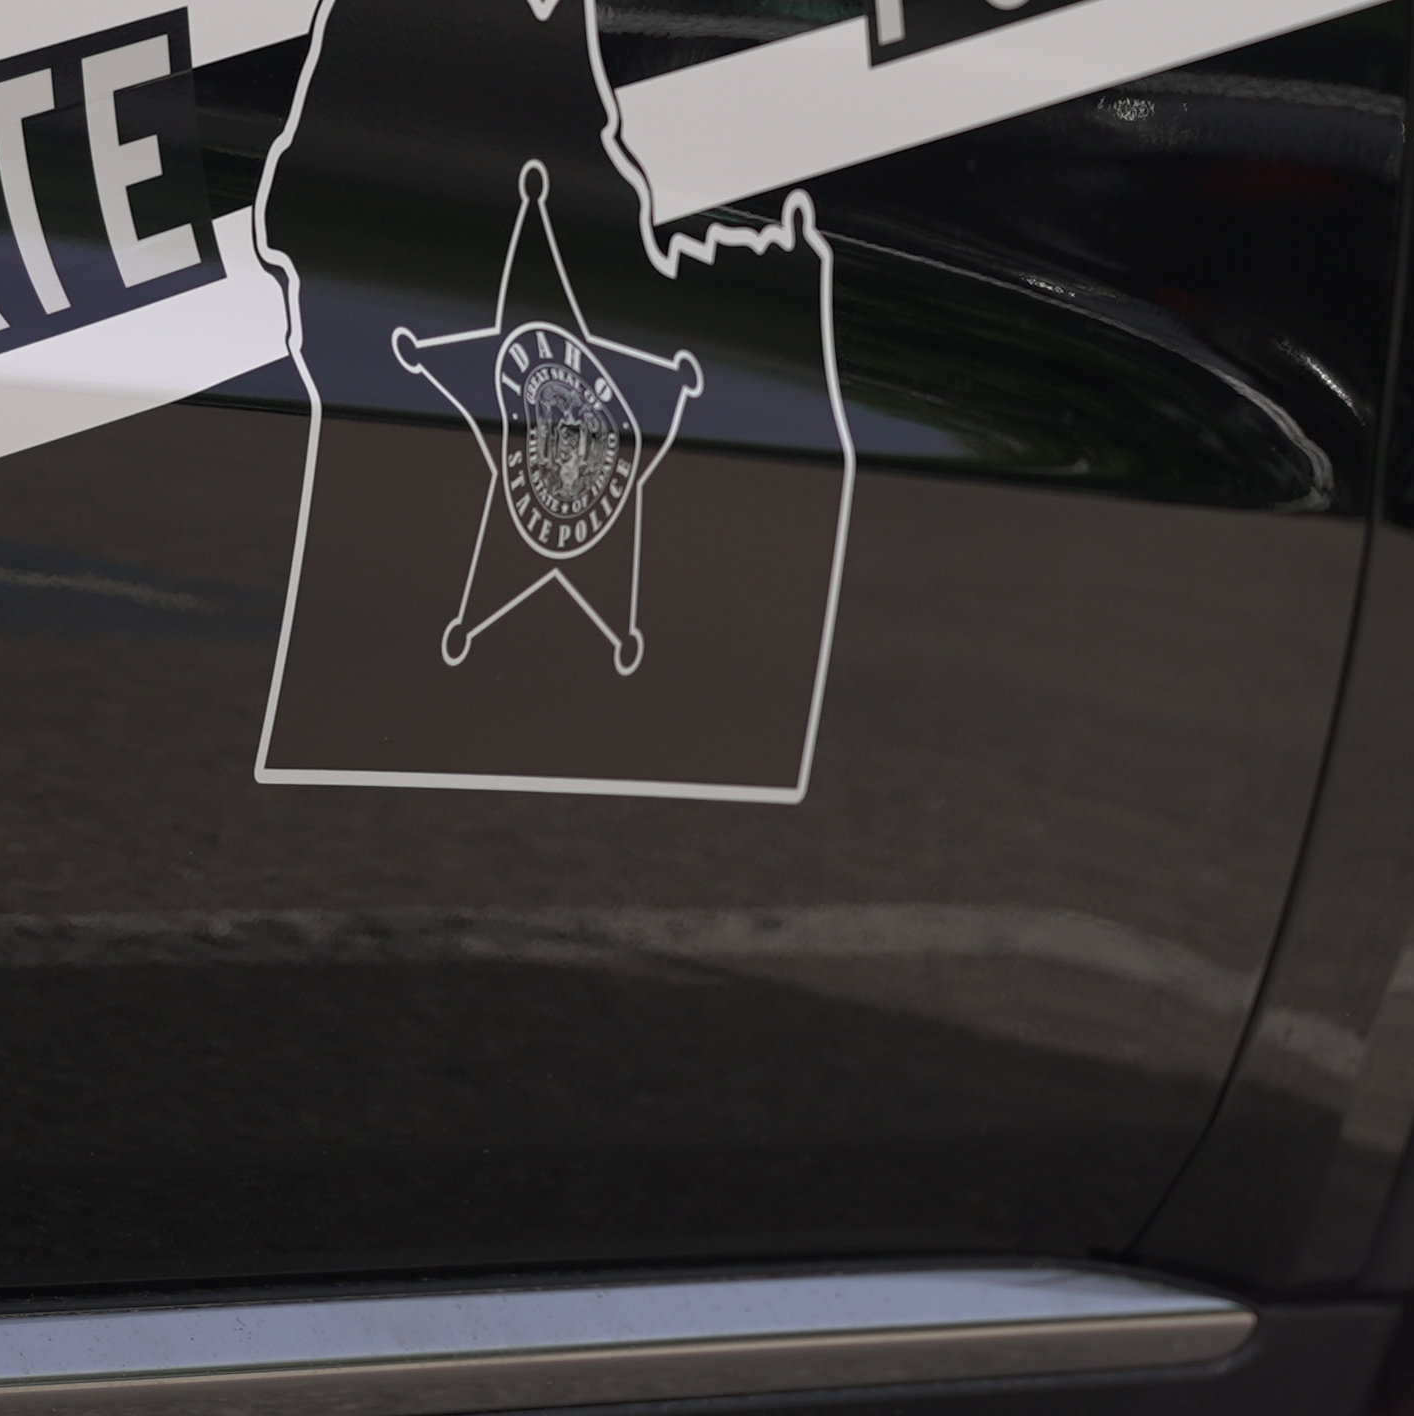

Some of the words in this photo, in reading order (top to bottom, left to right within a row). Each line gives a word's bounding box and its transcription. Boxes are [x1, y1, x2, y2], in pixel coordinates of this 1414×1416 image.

[502, 331, 613, 402] IDAHO
[508, 450, 553, 544] STATE
[557, 457, 632, 548] POLICE
[572, 494, 589, 513] OF
